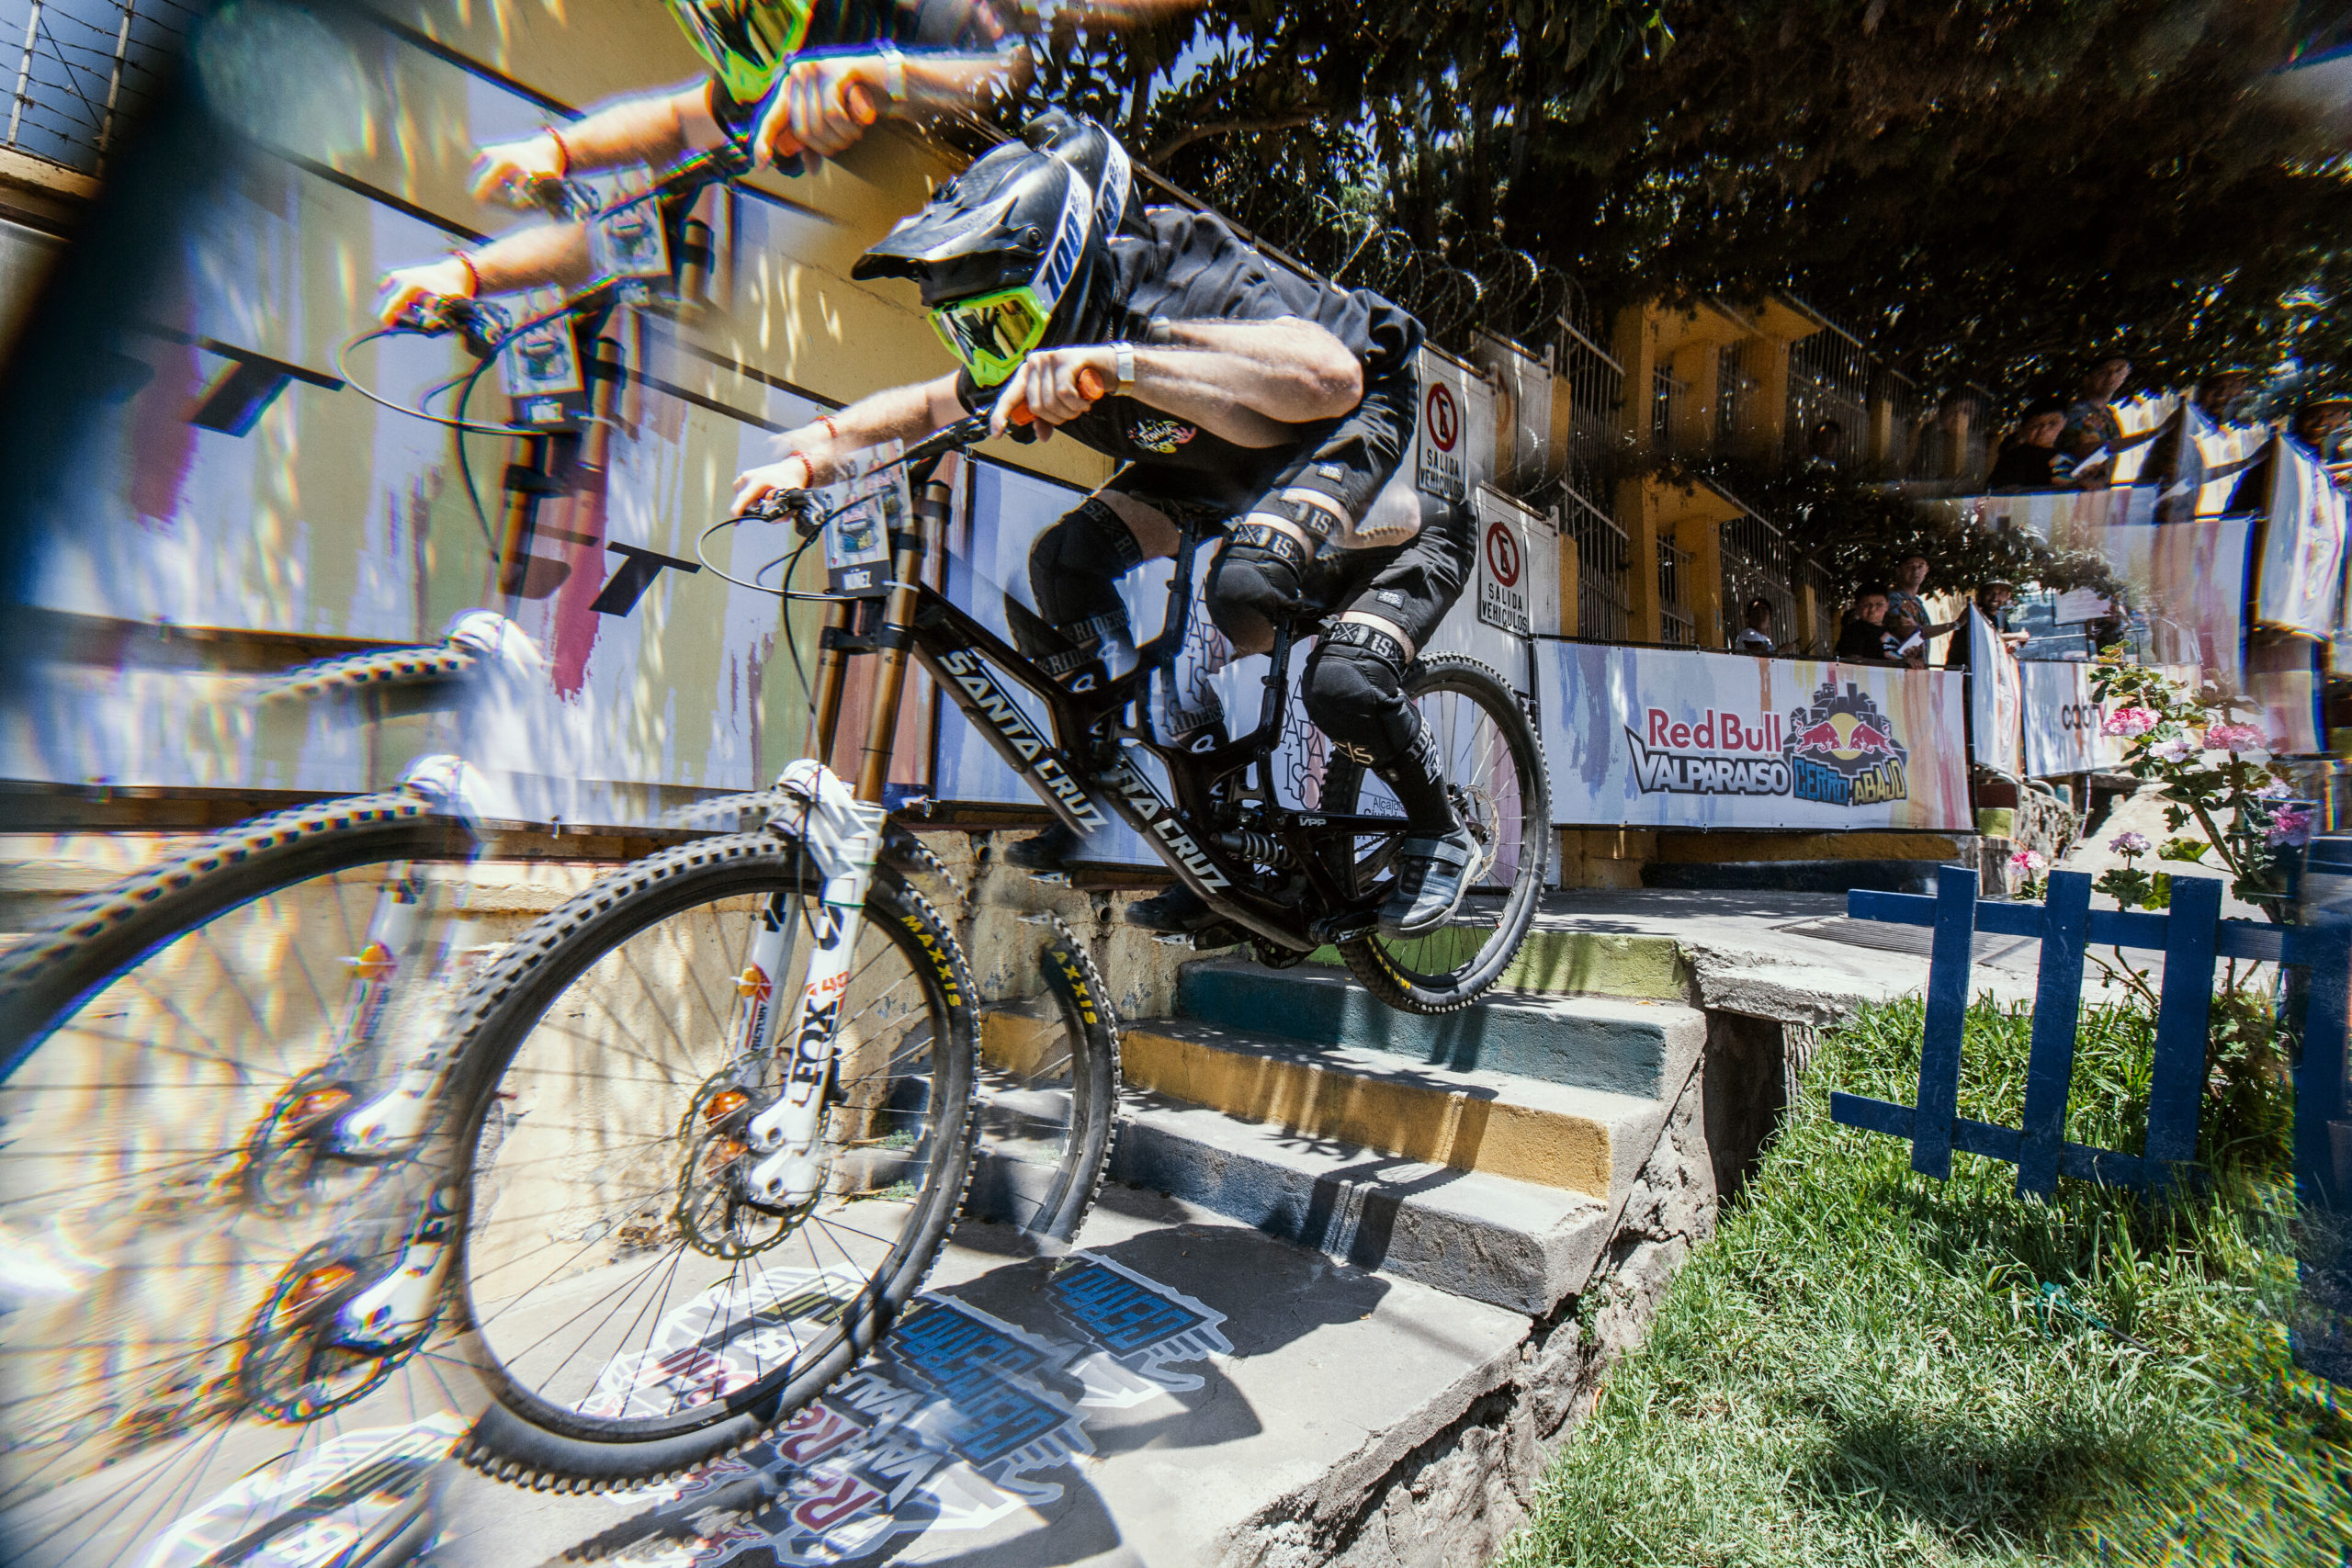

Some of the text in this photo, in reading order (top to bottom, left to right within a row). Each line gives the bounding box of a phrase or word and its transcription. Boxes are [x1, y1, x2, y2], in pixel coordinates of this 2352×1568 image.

[1426, 448, 1459, 476] SALIDA
[1481, 600, 1528, 634] VEHICULOS
[1487, 582, 1523, 612] SALIDA
[937, 650, 1110, 833] SANTA CRUZ
[1624, 725, 1791, 795] VALPARAISO
[1647, 708, 1782, 753] Red Bull
[1792, 756, 1907, 806] CERRO ABAJO
[1153, 818, 1232, 895] CRUZ
[901, 915, 963, 1008] MAXXIS
[791, 998, 839, 1087] FOX
